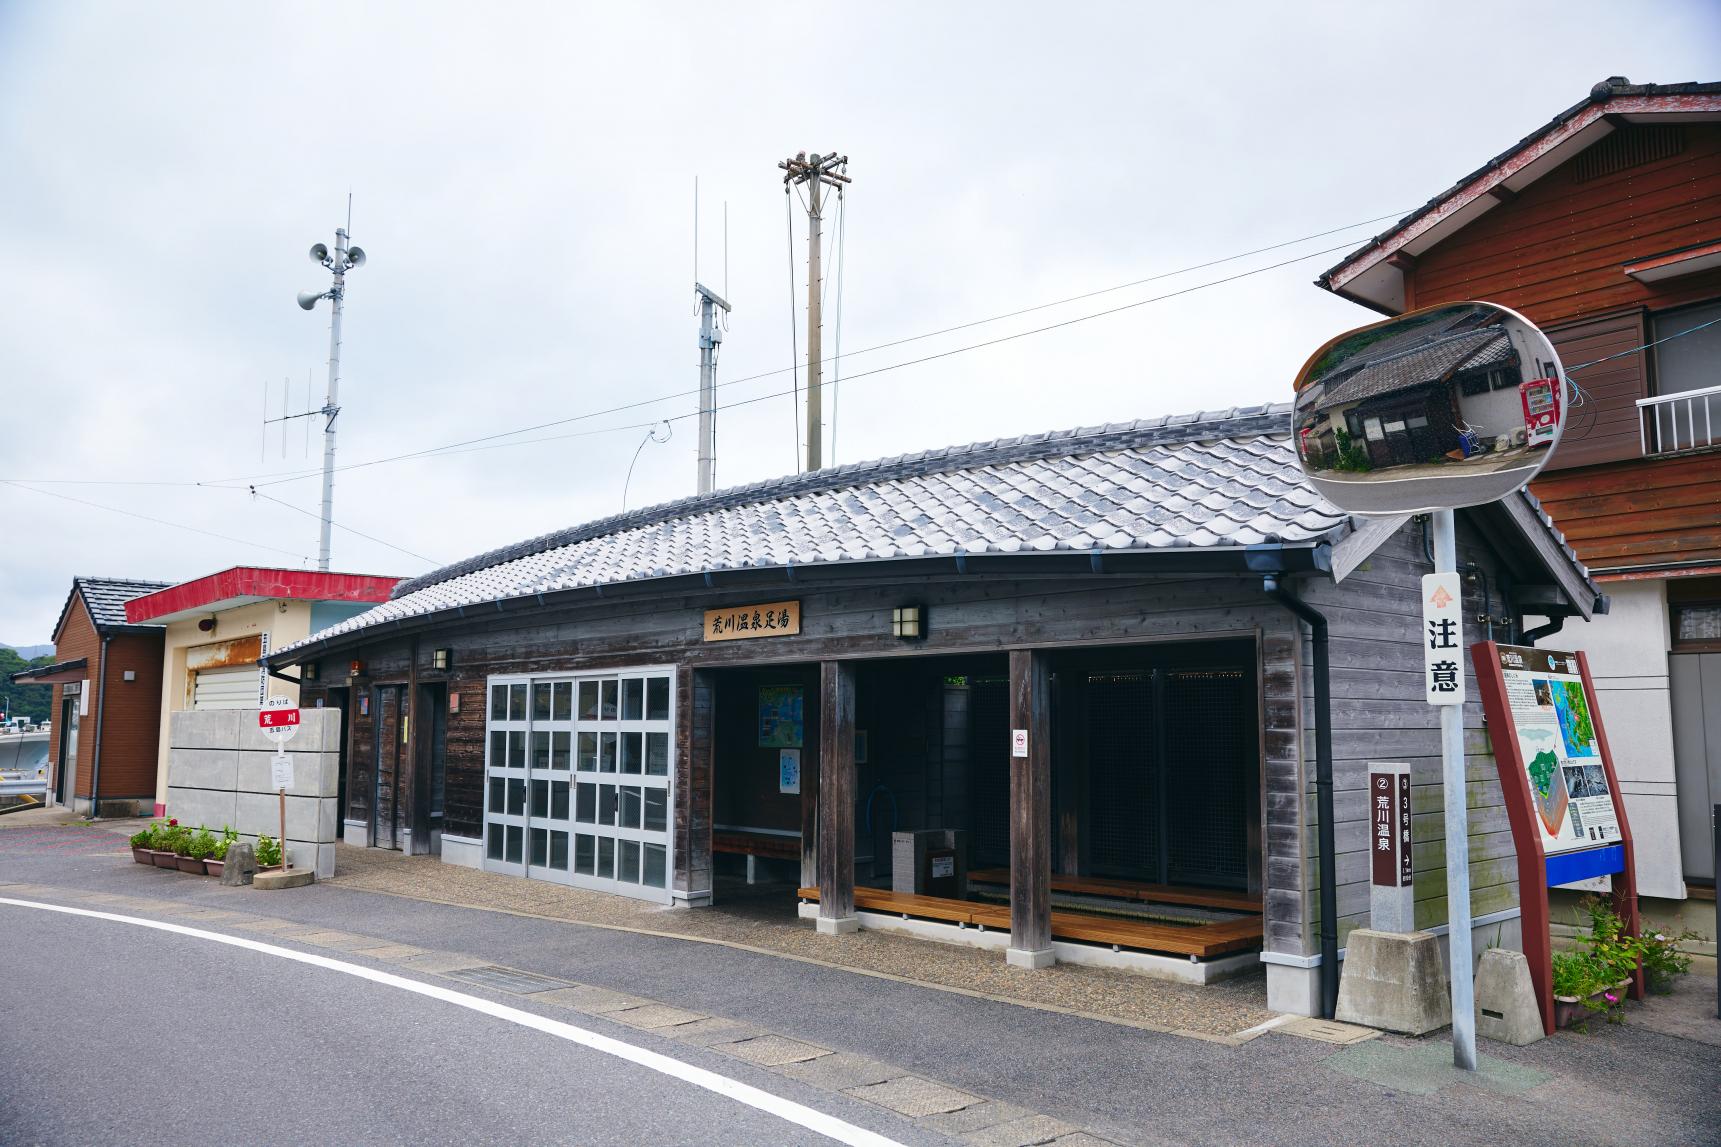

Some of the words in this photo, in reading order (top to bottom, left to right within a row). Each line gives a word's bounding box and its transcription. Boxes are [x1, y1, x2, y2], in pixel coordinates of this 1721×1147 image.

[712, 608, 790, 635] 荒川温泉足湯
[1428, 618, 1459, 692] 注意
[268, 699, 288, 707] のりば
[263, 712, 296, 725] 荒川
[1376, 795, 1391, 851] 荒川温泉
